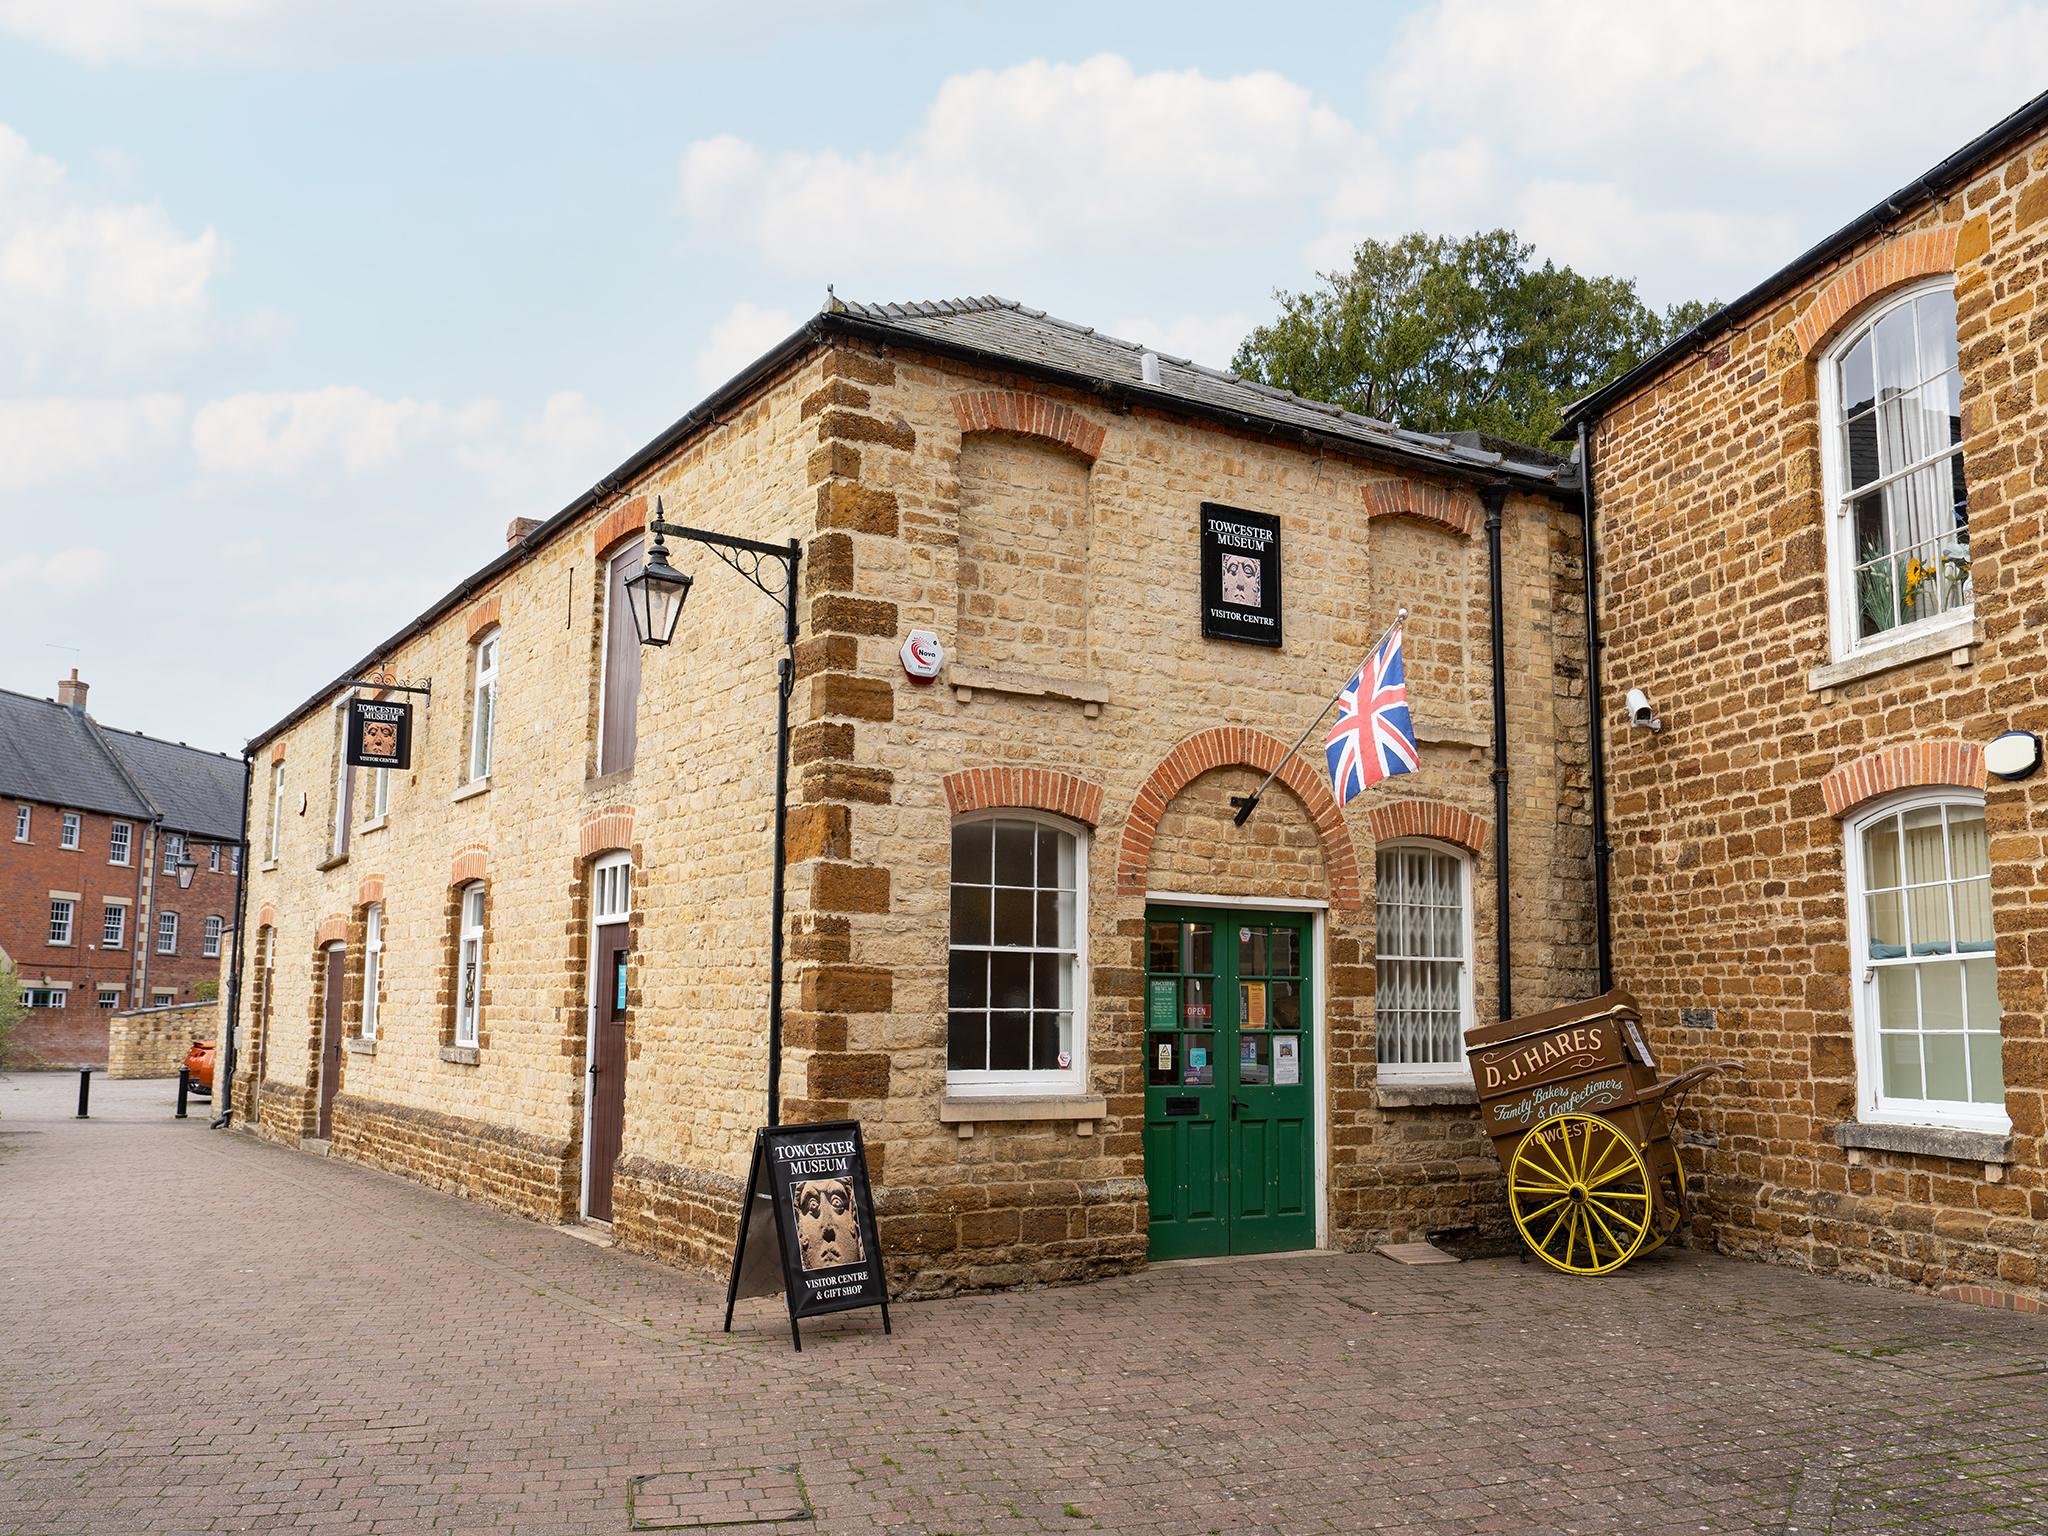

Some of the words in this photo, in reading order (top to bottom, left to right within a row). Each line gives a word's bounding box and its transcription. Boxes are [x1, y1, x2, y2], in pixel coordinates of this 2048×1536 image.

[1208, 519, 1273, 541] TOWCESTER
[1217, 533, 1265, 552] MUSEUM
[1210, 608, 1242, 621] VISITOR
[1243, 614, 1275, 626] CENTRE
[356, 703, 405, 716] TOWCESTER
[363, 711, 399, 722] MUSEUM
[1187, 1007, 1206, 1016] OPEN
[1493, 1098, 1534, 1123] Family
[1532, 1084, 1569, 1106] Bakers
[1537, 1105, 1547, 1119] &
[775, 1140, 856, 1160] TOWCESTER
[790, 1157, 848, 1175] MUSEUM
[805, 1276, 837, 1289] VISITOR
[837, 1271, 869, 1284] CENTRE
[816, 1291, 823, 1300] &
[823, 1287, 841, 1299] GIFT
[842, 1284, 863, 1296] SHOP
